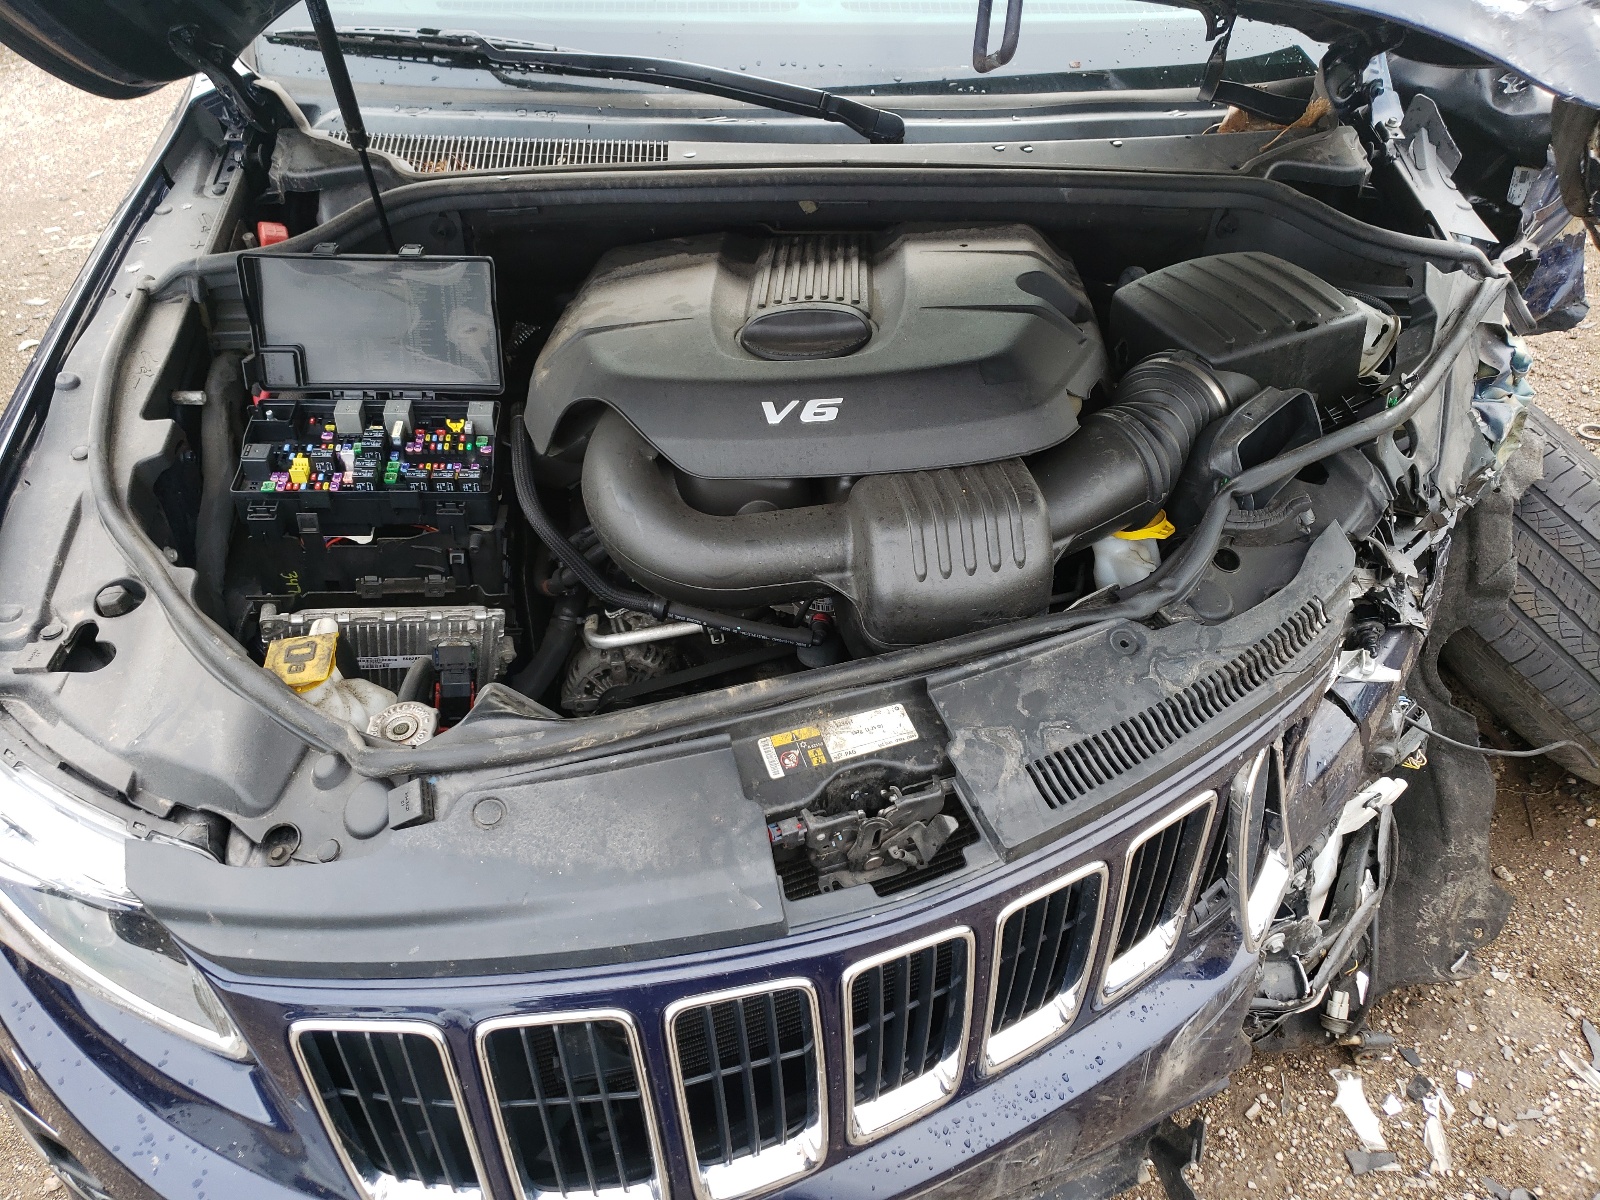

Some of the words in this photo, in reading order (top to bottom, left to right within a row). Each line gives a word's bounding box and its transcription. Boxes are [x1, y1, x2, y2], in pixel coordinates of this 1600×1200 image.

[761, 397, 844, 425] V6
[384, 705, 408, 718] KEEP
[409, 704, 430, 718] TIGHT
